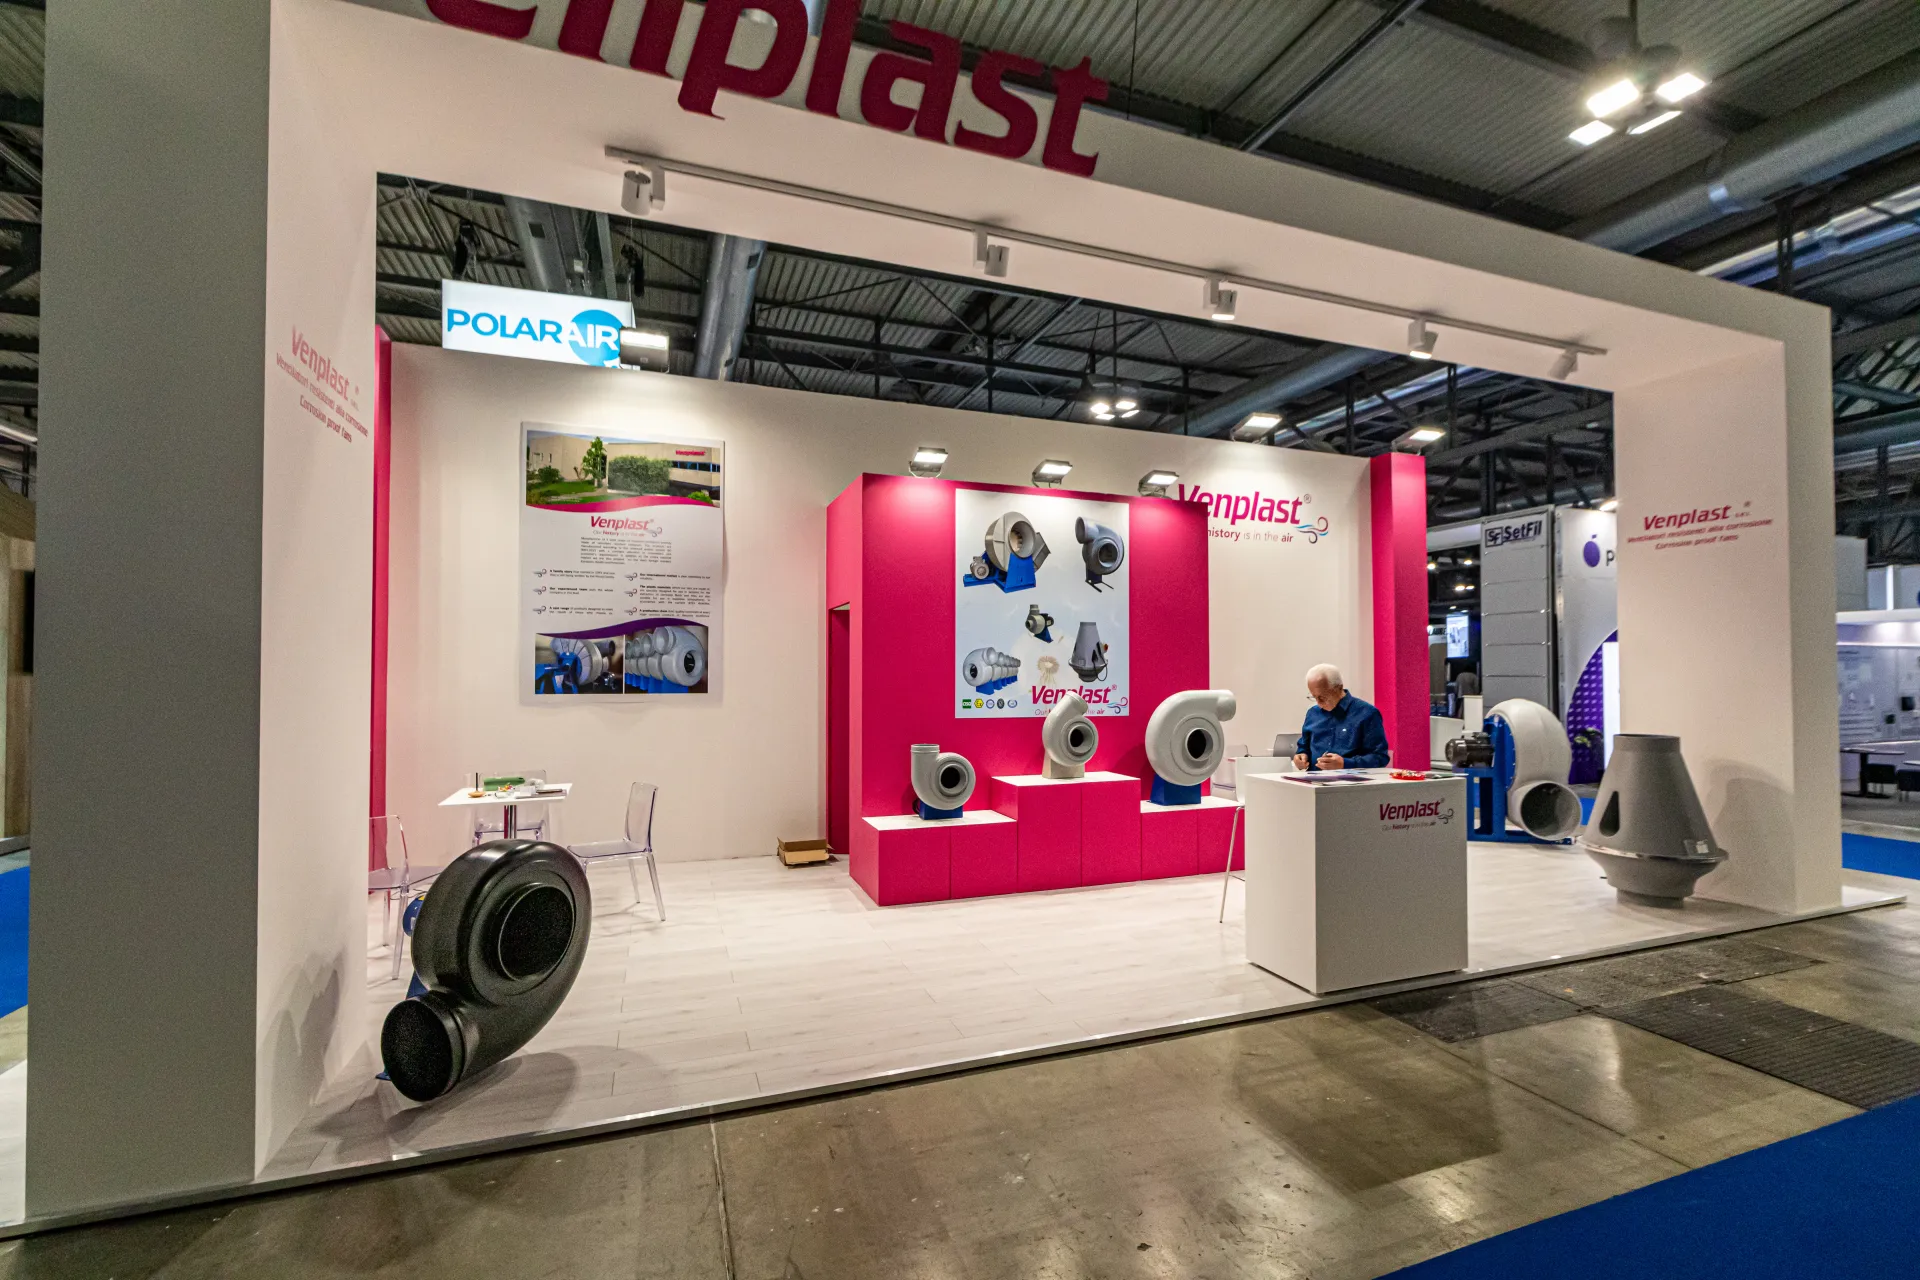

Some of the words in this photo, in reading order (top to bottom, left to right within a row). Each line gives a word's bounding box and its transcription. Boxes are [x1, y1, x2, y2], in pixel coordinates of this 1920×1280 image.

[447, 308, 618, 350] POLARAIR
[1243, 532, 1250, 540] is
[1253, 532, 1261, 541] in
[1264, 532, 1278, 542] the
[1281, 533, 1293, 542] air
[1031, 685, 1112, 705] Venlast
